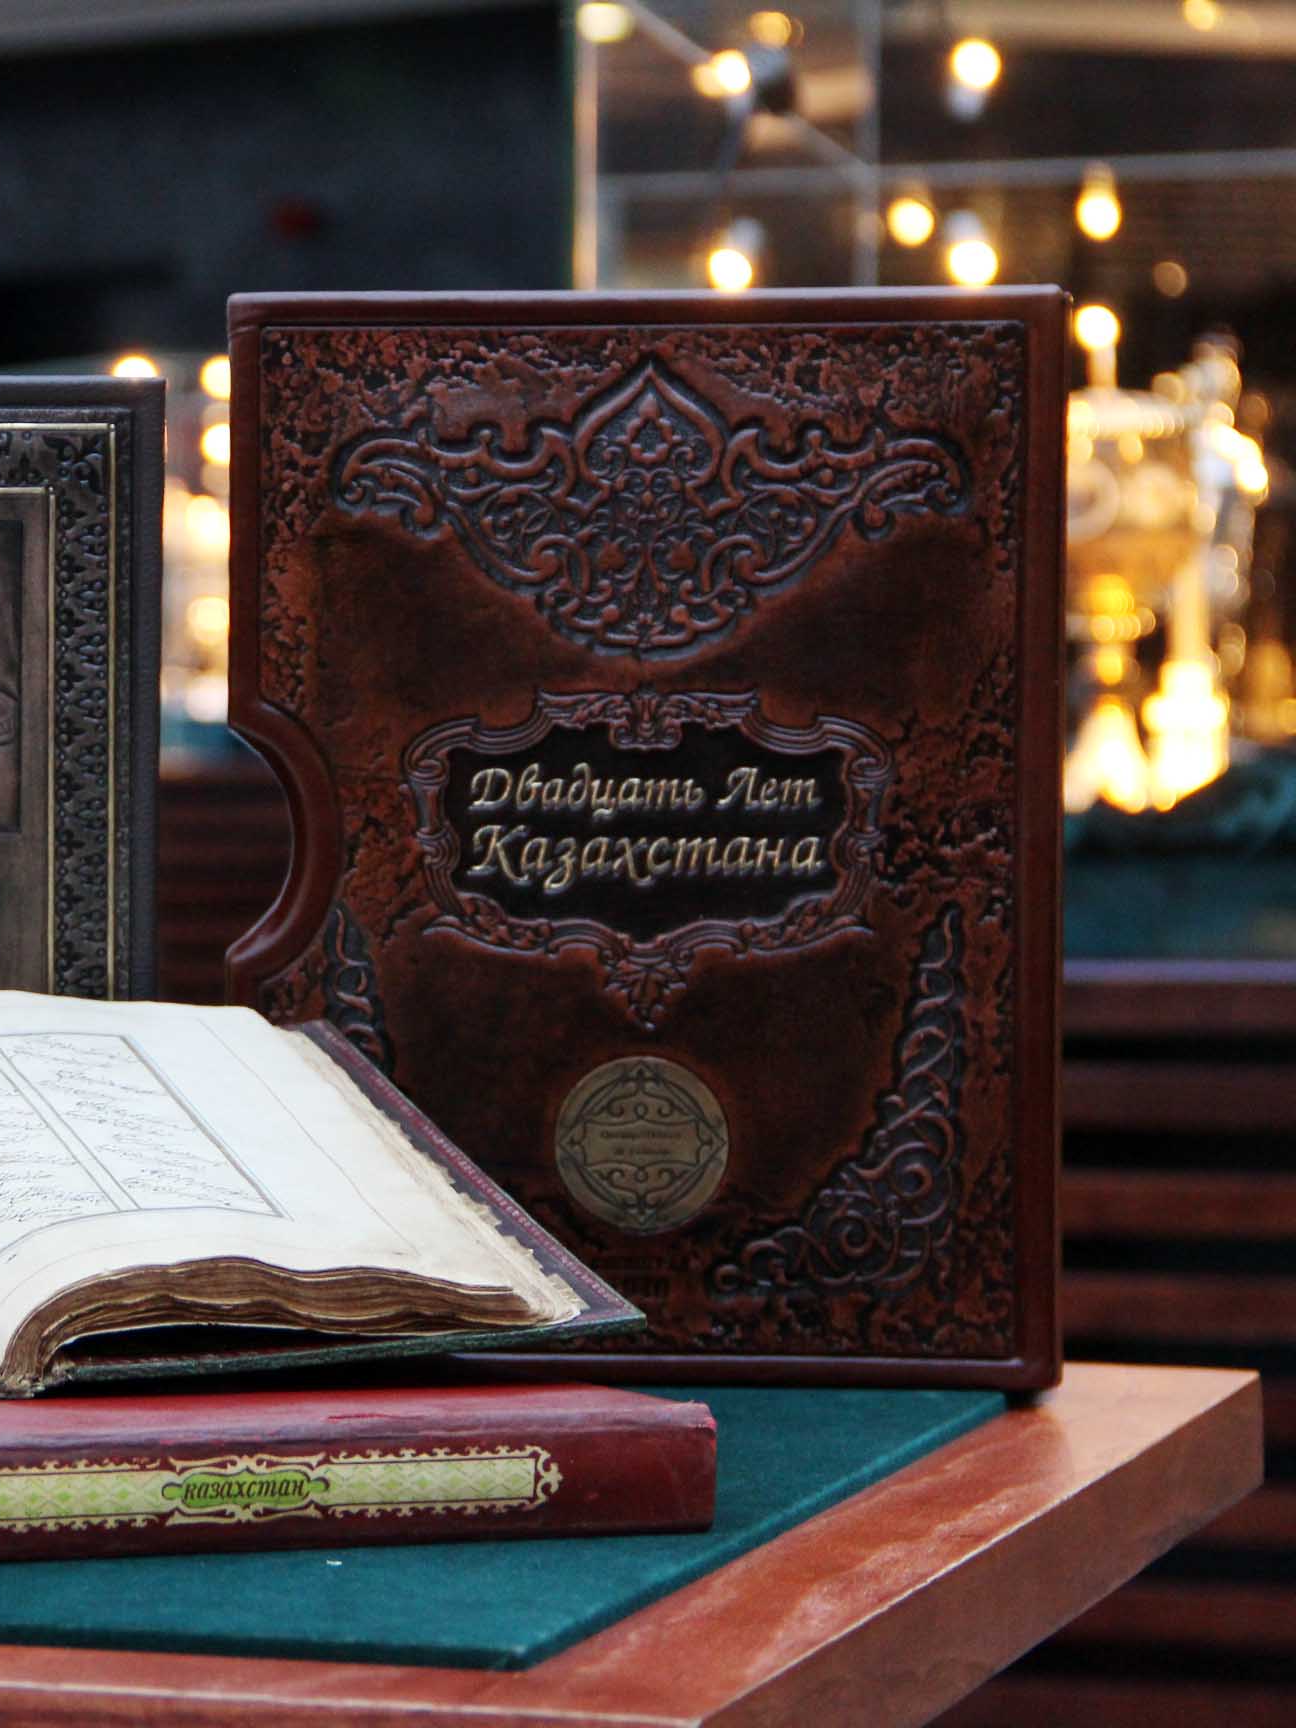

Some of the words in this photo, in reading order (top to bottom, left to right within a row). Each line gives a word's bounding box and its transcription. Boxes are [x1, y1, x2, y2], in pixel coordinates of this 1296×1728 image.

[469, 763, 705, 821] Двадцать
[717, 767, 823, 811] Лет
[467, 824, 827, 894] Казахстана
[182, 1479, 305, 1501] казахстан
